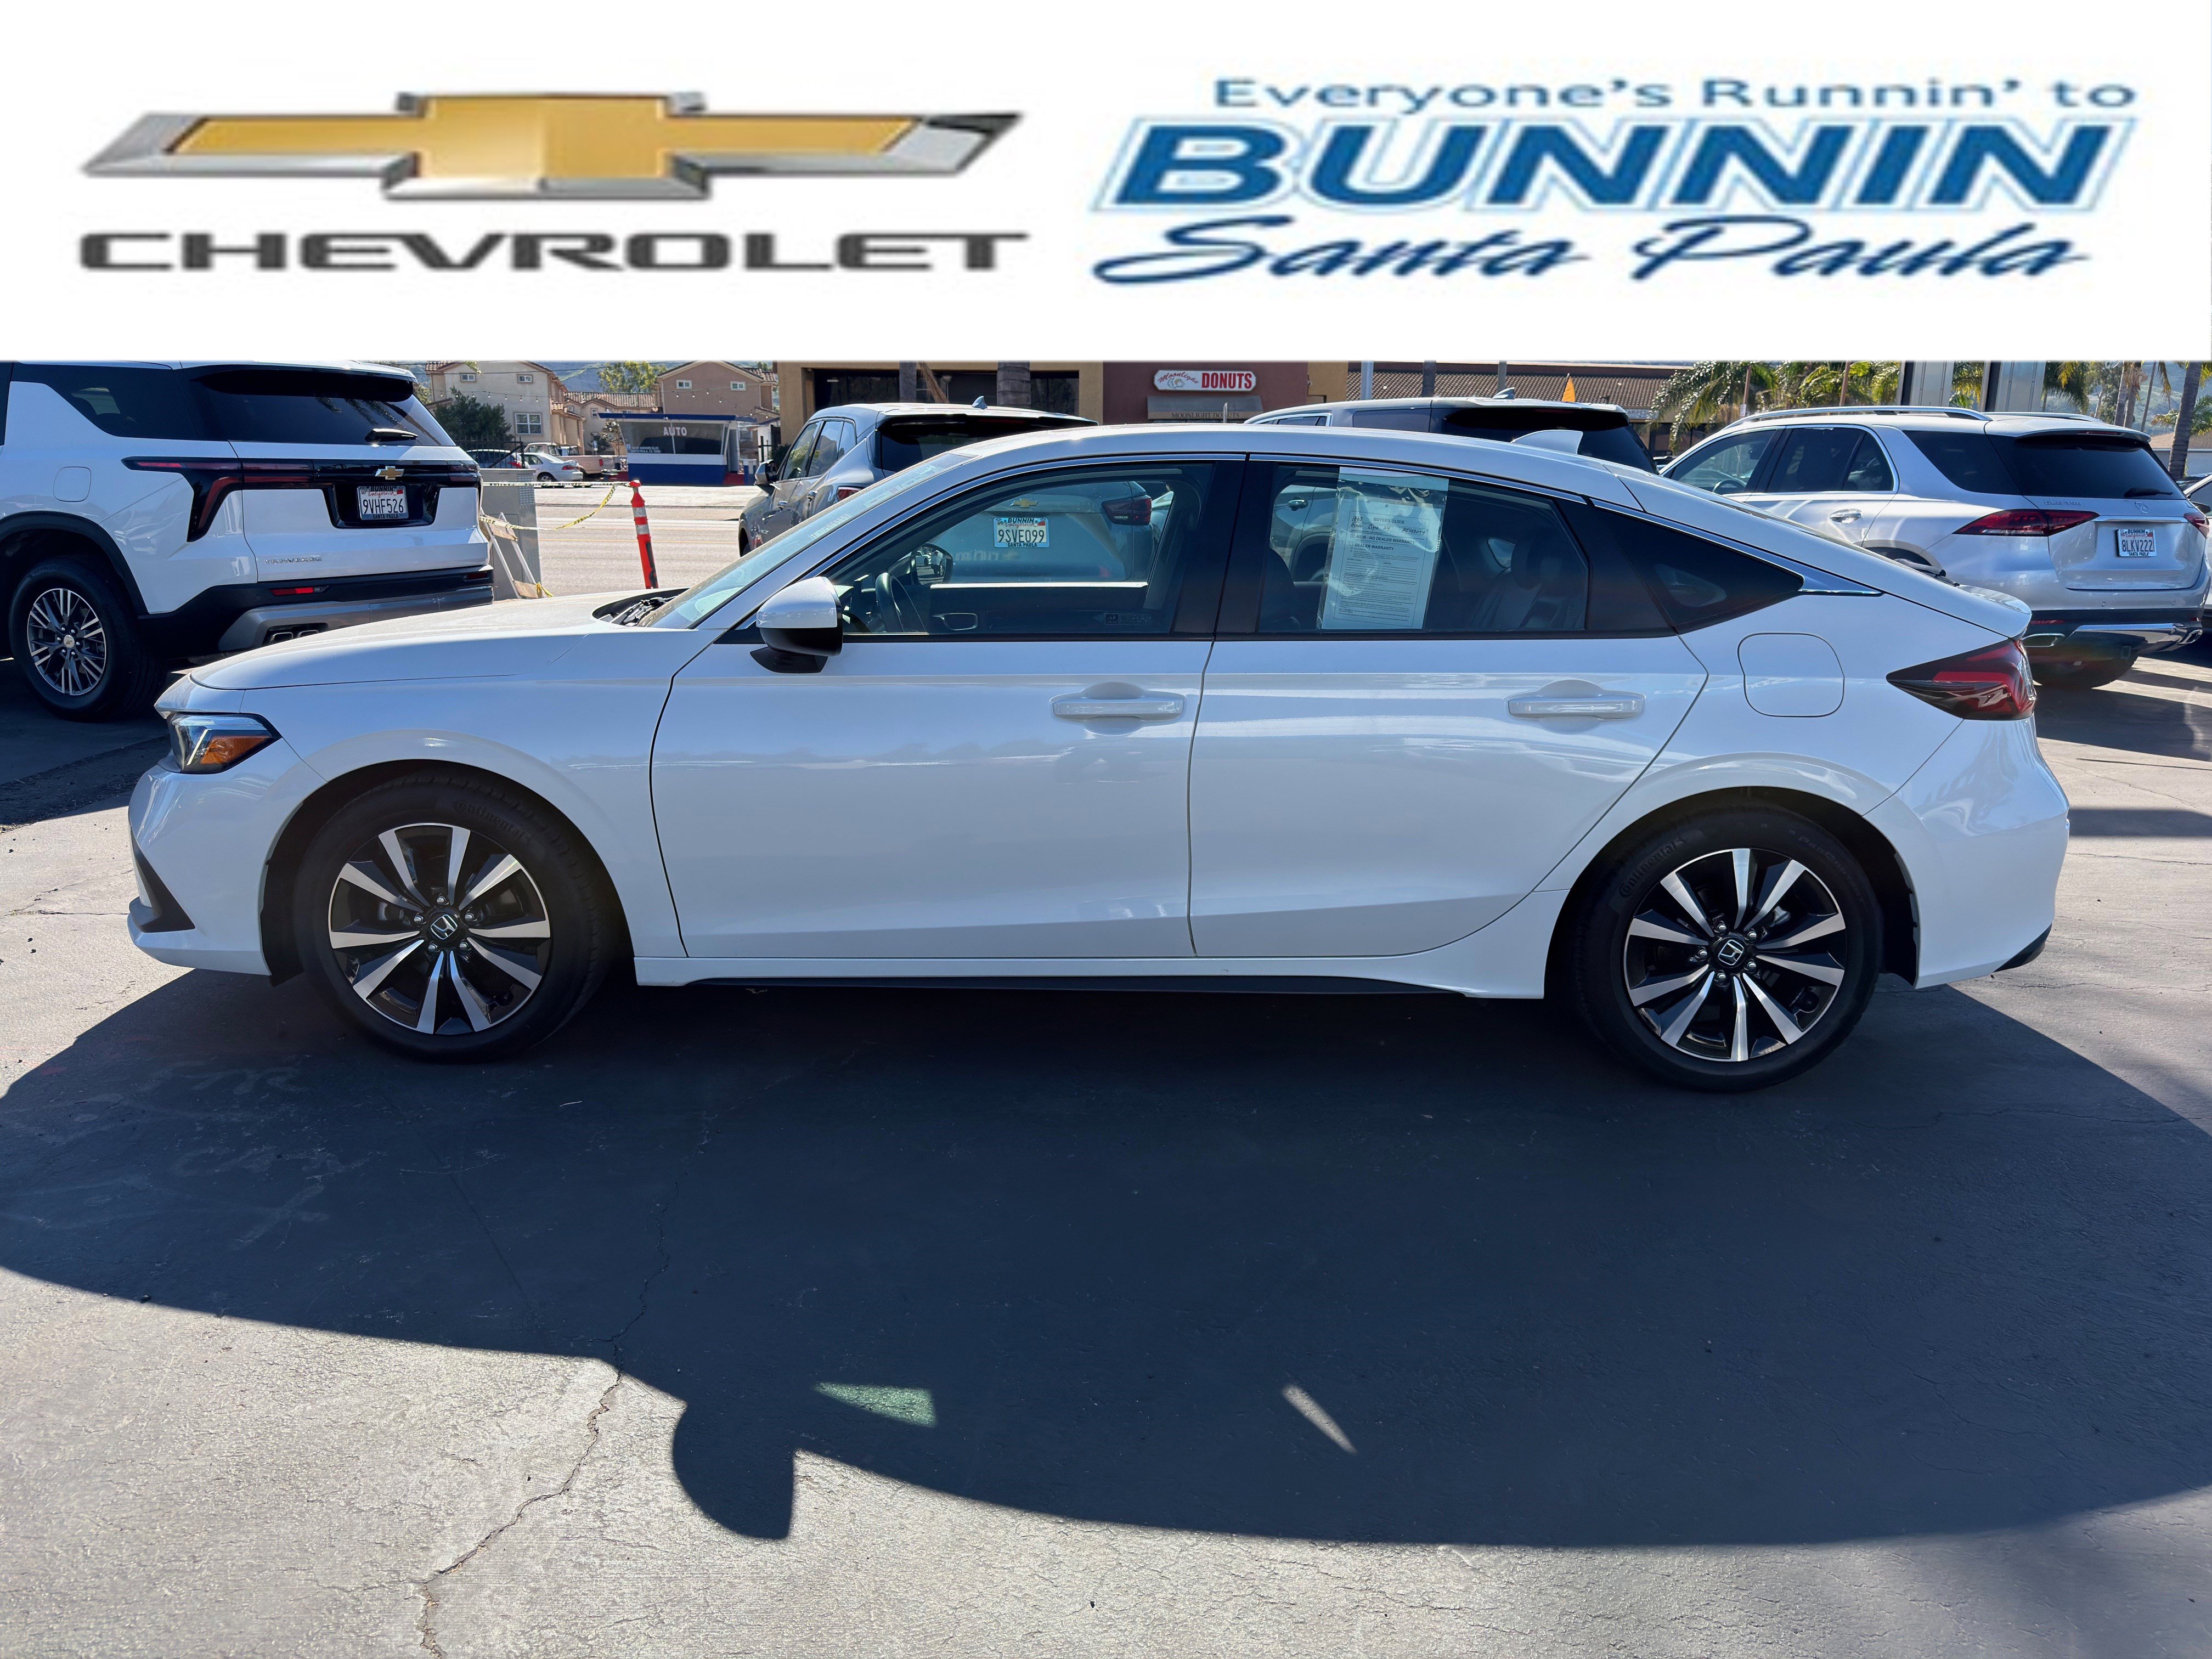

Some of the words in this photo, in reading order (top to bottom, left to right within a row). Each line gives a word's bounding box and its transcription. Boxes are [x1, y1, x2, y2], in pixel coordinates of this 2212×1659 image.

[1158, 371, 1199, 384] Moonlight
[1201, 372, 1252, 390] DONUTS
[663, 426, 687, 436] AUTO
[363, 498, 404, 514] 9VHF526
[998, 529, 1045, 543] 9SVE099
[2121, 539, 2154, 552] 8LKV222
